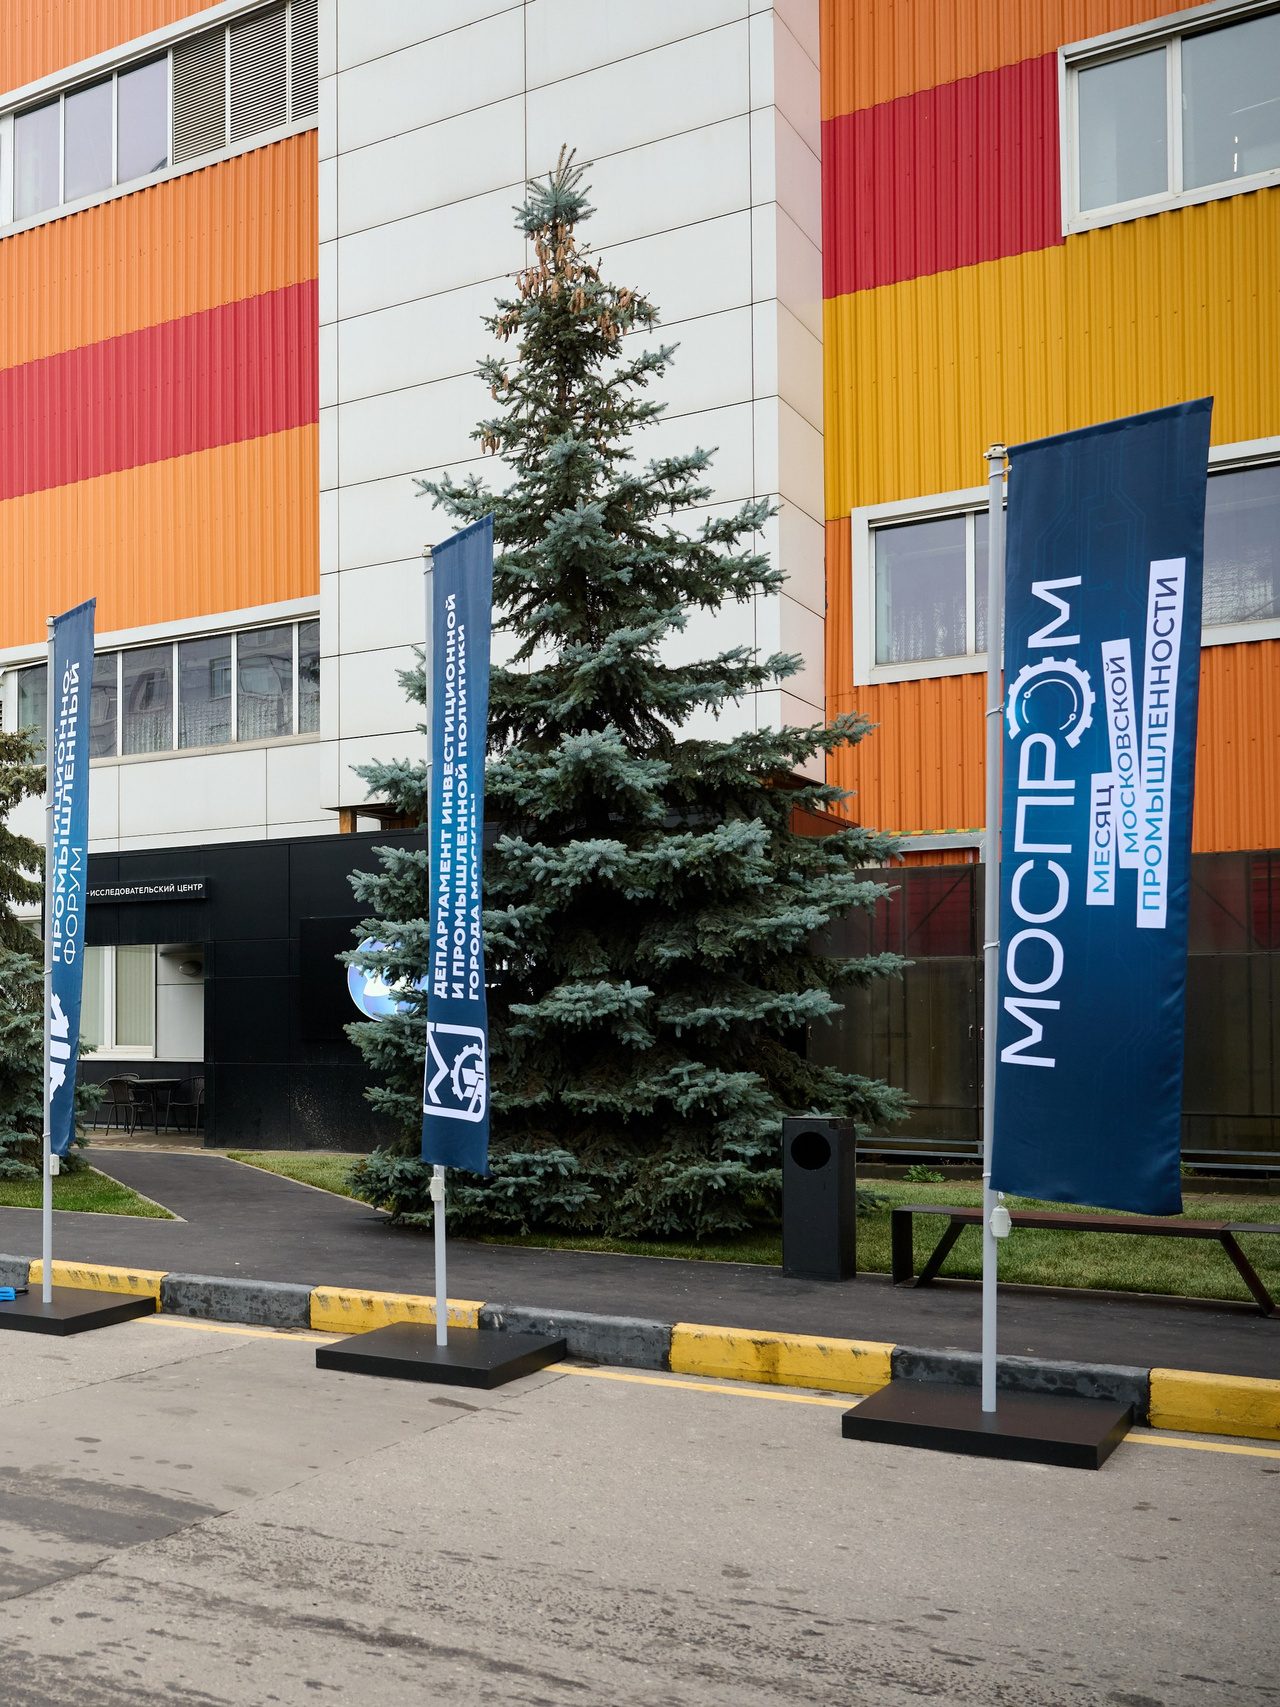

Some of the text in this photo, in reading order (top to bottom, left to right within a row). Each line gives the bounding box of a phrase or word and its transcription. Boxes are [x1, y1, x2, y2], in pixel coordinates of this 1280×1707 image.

[52, 662, 79, 962] ПРОМЫШЛЕННЫЙ
[434, 594, 456, 999] ДЕПАРТАМЕНТ ИНВЕСТИЦИОННОЙ
[452, 624, 468, 999] И ПРОМЫШЛЕННОЙ ПОЛИТИКИ
[1093, 785, 1114, 892] МЕСЯЦ
[1105, 656, 1139, 852] МОСКОВСКОЙ
[1143, 577, 1178, 910] ПРОМЫШЛЕННОСТИ
[63, 848, 83, 965] ФОРУМ
[177, 883, 203, 892] ЦЕНТР
[469, 905, 481, 1000] ГОРОДА
